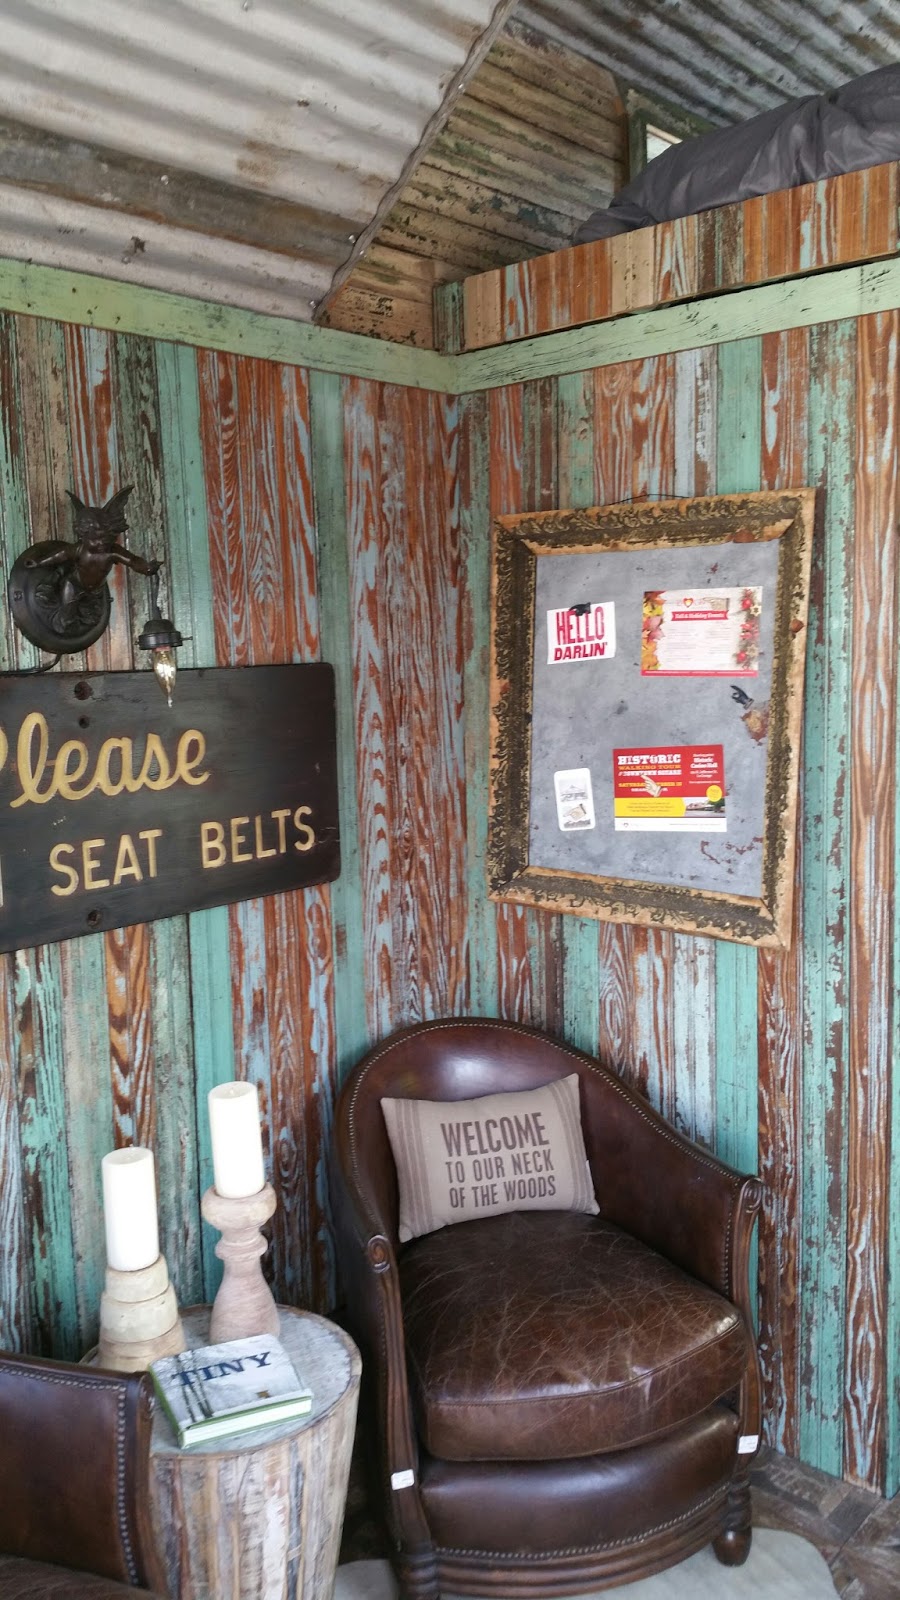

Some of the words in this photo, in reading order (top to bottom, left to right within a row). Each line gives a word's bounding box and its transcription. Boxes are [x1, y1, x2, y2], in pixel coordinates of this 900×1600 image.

[556, 606, 605, 645] HELLO
[554, 642, 608, 661] DARLIN'
[618, 754, 681, 765] HISTORIC
[50, 829, 163, 896] SEAT
[200, 806, 316, 869] BELTS
[440, 1112, 550, 1157] WELCOME
[445, 1161, 465, 1183] TO
[472, 1156, 505, 1182] OUR
[511, 1149, 554, 1175] NECK
[449, 1187, 465, 1208] OF
[472, 1184, 499, 1207] THE
[503, 1175, 556, 1201] WOODS
[171, 1351, 271, 1386] TINY
